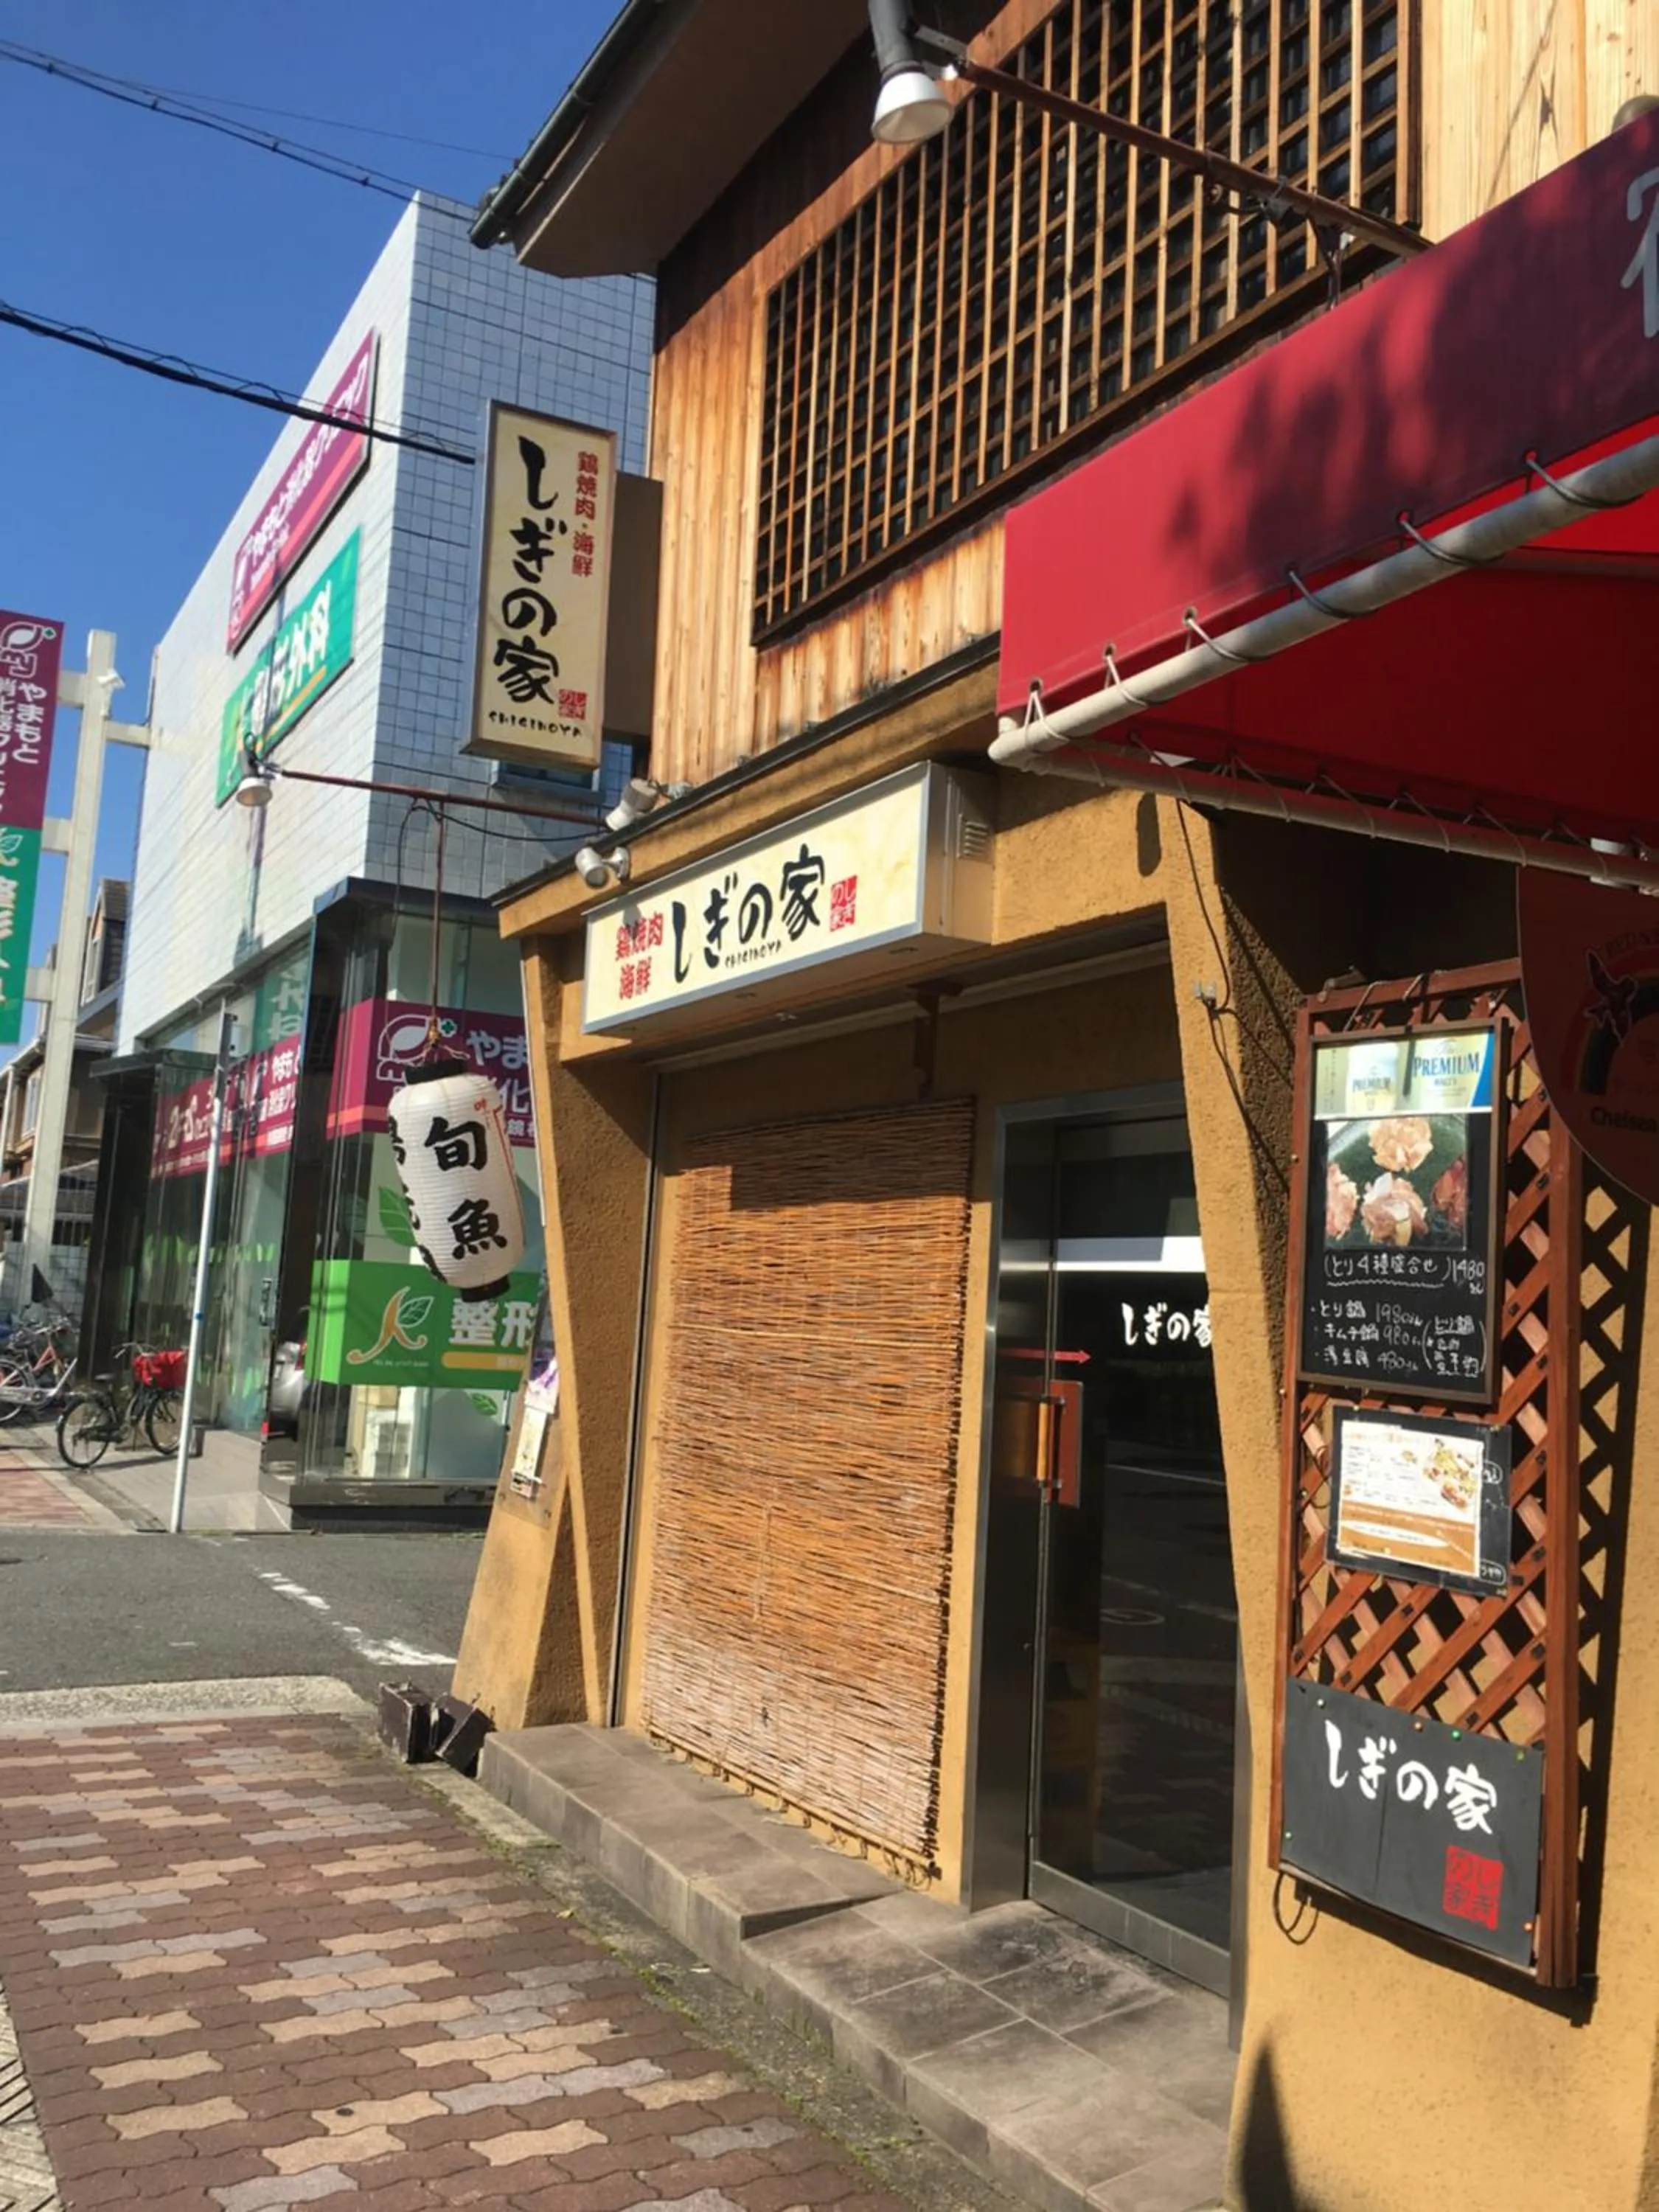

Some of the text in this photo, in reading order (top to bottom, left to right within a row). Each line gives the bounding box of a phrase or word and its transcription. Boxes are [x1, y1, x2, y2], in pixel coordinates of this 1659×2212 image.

[493, 434, 567, 706] しぎの家
[672, 843, 825, 984] しぎの家
[1413, 1053, 1480, 1077] PREMIUM
[424, 1116, 507, 1260] 旬魚
[1325, 1719, 1498, 1835] しぎの家
